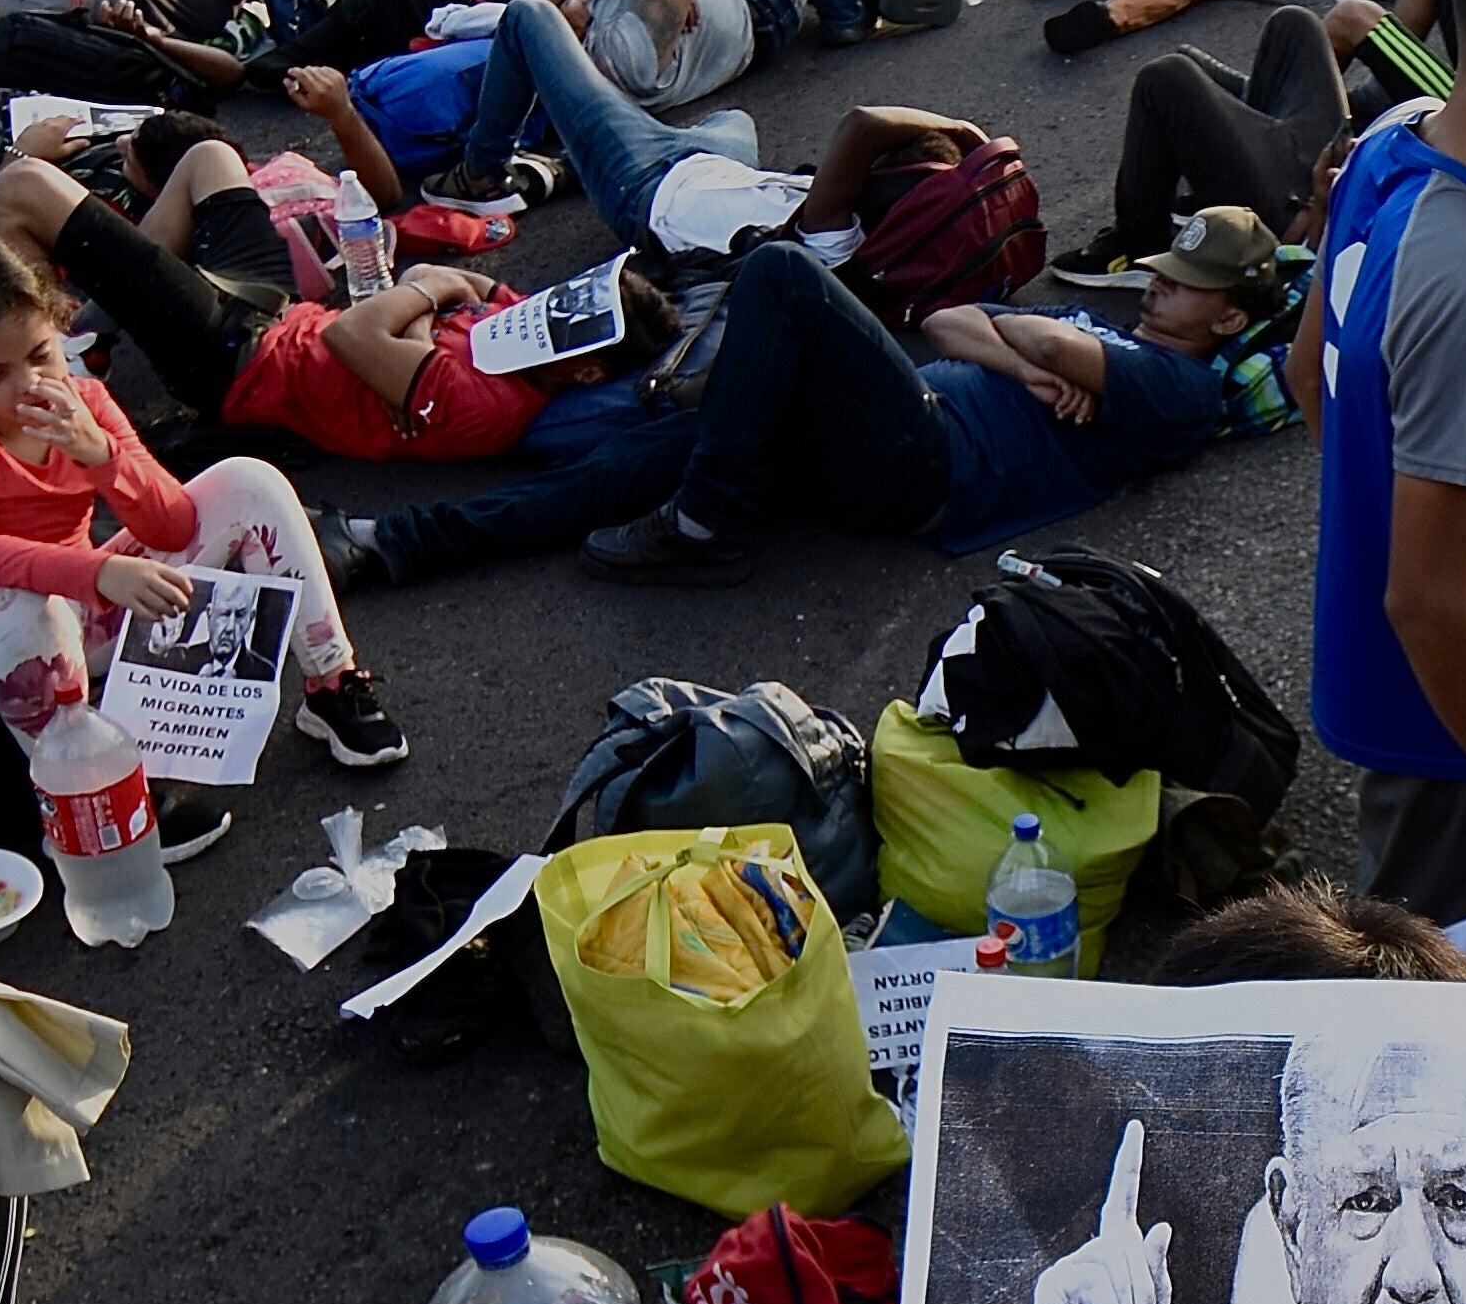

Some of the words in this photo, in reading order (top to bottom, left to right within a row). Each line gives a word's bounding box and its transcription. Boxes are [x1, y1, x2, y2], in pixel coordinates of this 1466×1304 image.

[534, 323, 547, 349] LOS
[128, 671, 151, 687] LA
[160, 677, 202, 695] VIDA
[207, 684, 228, 697] DE
[233, 686, 263, 699] LOS
[140, 696, 246, 720] MIGRANTES
[149, 719, 230, 739] TAMBIEN
[136, 739, 225, 760] MPORTAN
[874, 971, 935, 990] ORTAN
[869, 1047, 891, 1063] LO
